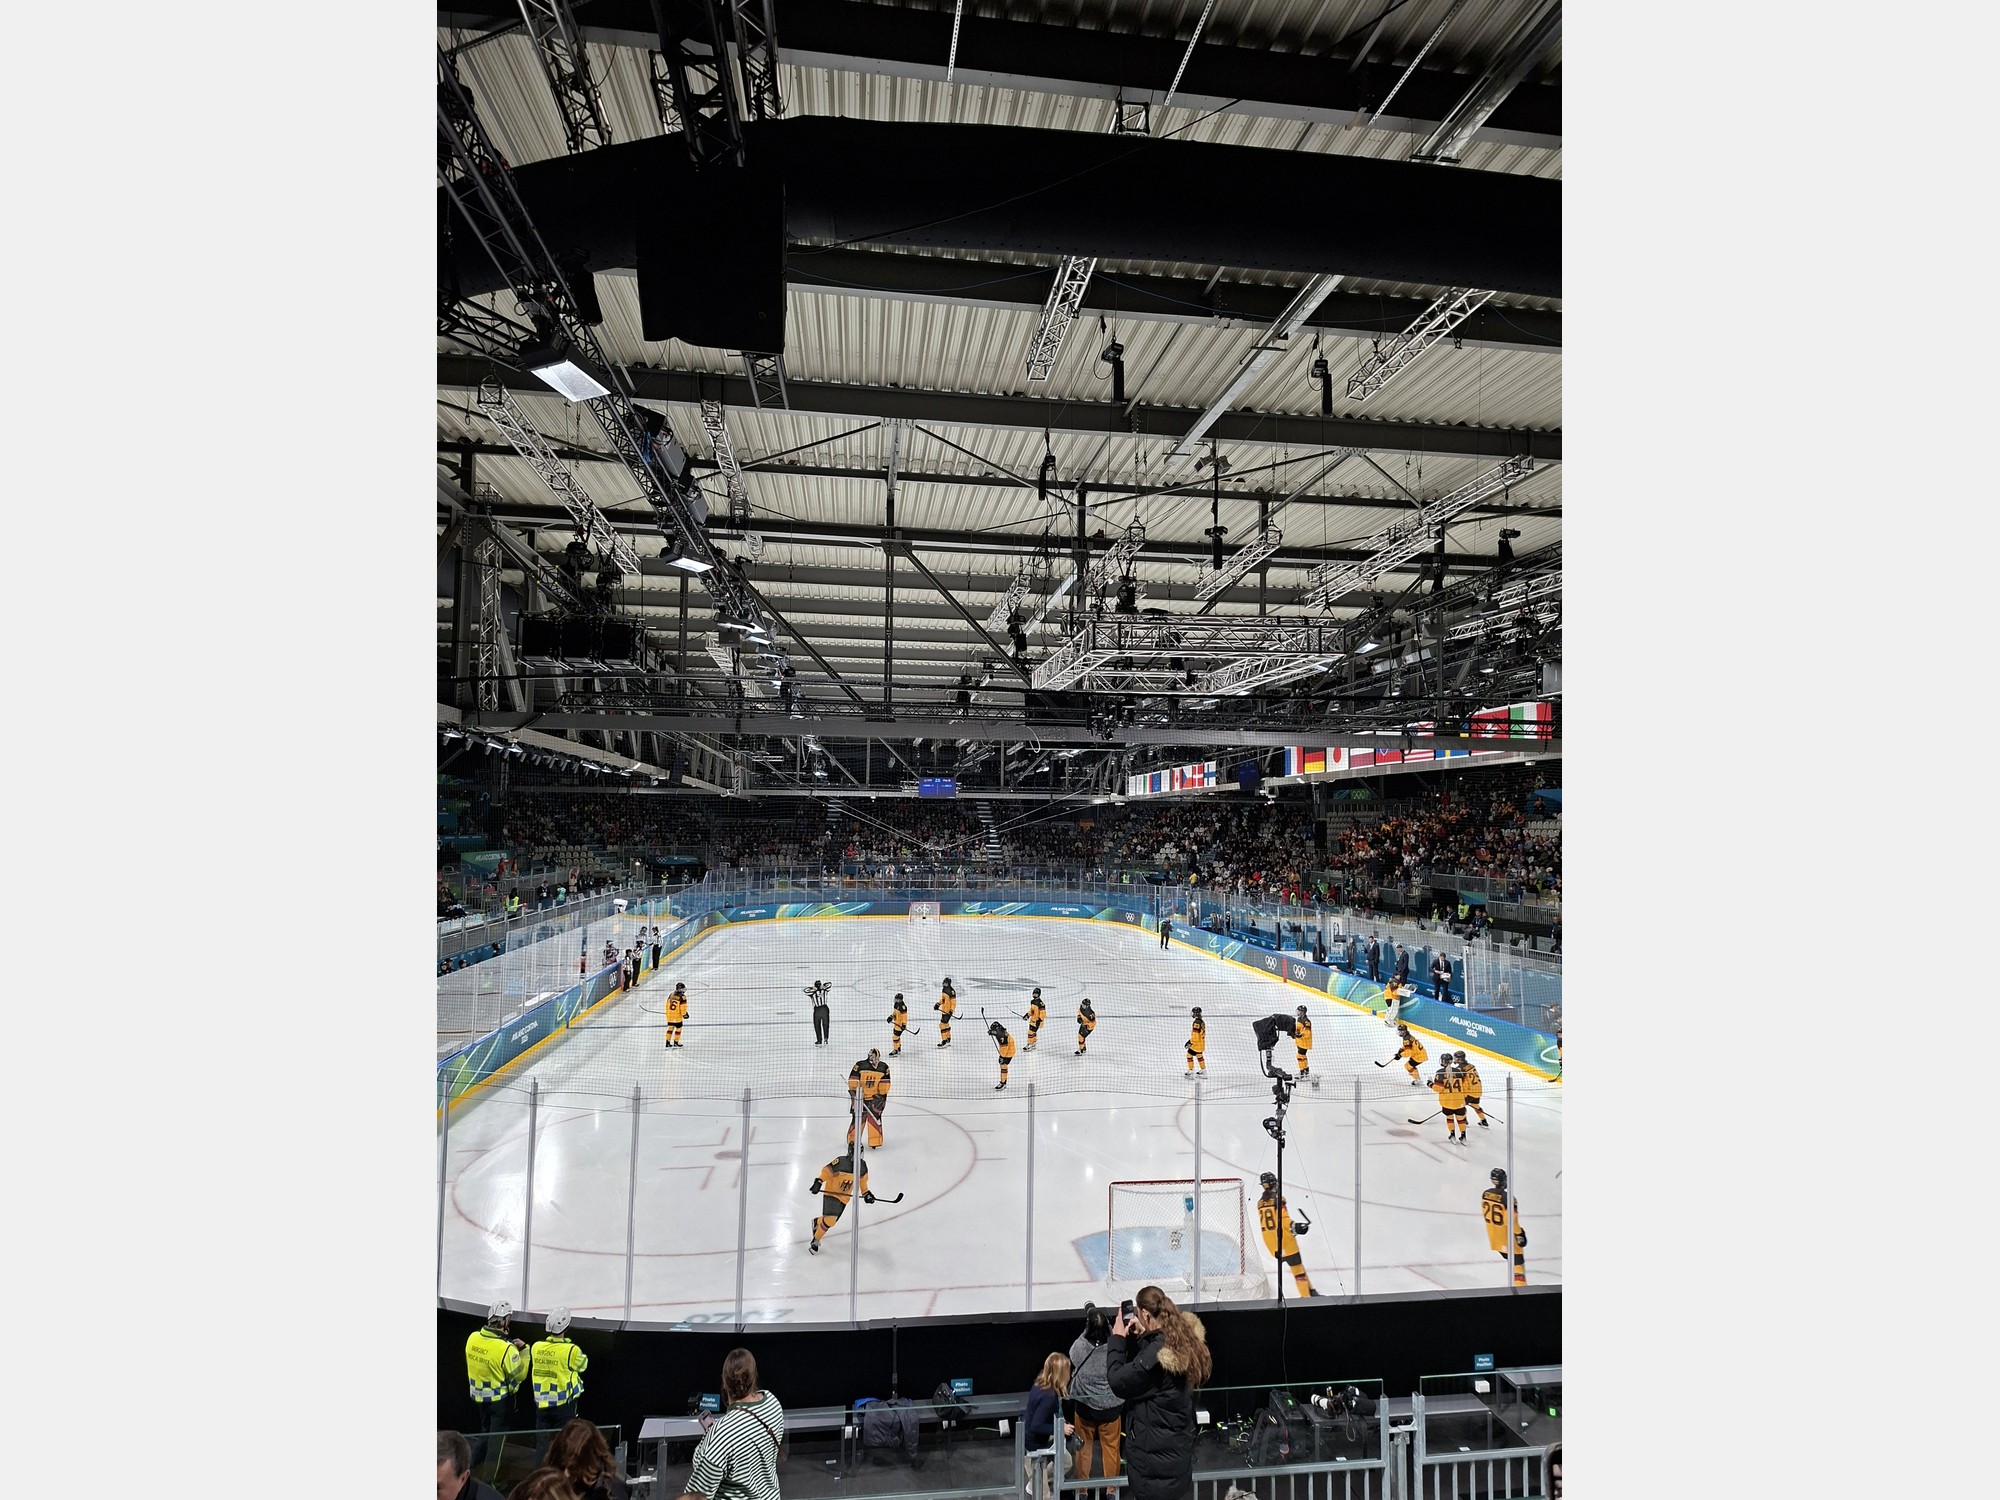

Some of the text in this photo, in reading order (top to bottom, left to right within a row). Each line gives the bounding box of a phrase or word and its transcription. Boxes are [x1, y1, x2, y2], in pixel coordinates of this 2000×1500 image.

[670, 1000, 678, 1011] 6
[1449, 1015, 1496, 1037] MILANO CORTINA
[1466, 1028, 1478, 1038] 2026
[1445, 1079, 1461, 1093] 44
[1482, 1201, 1504, 1226] 26
